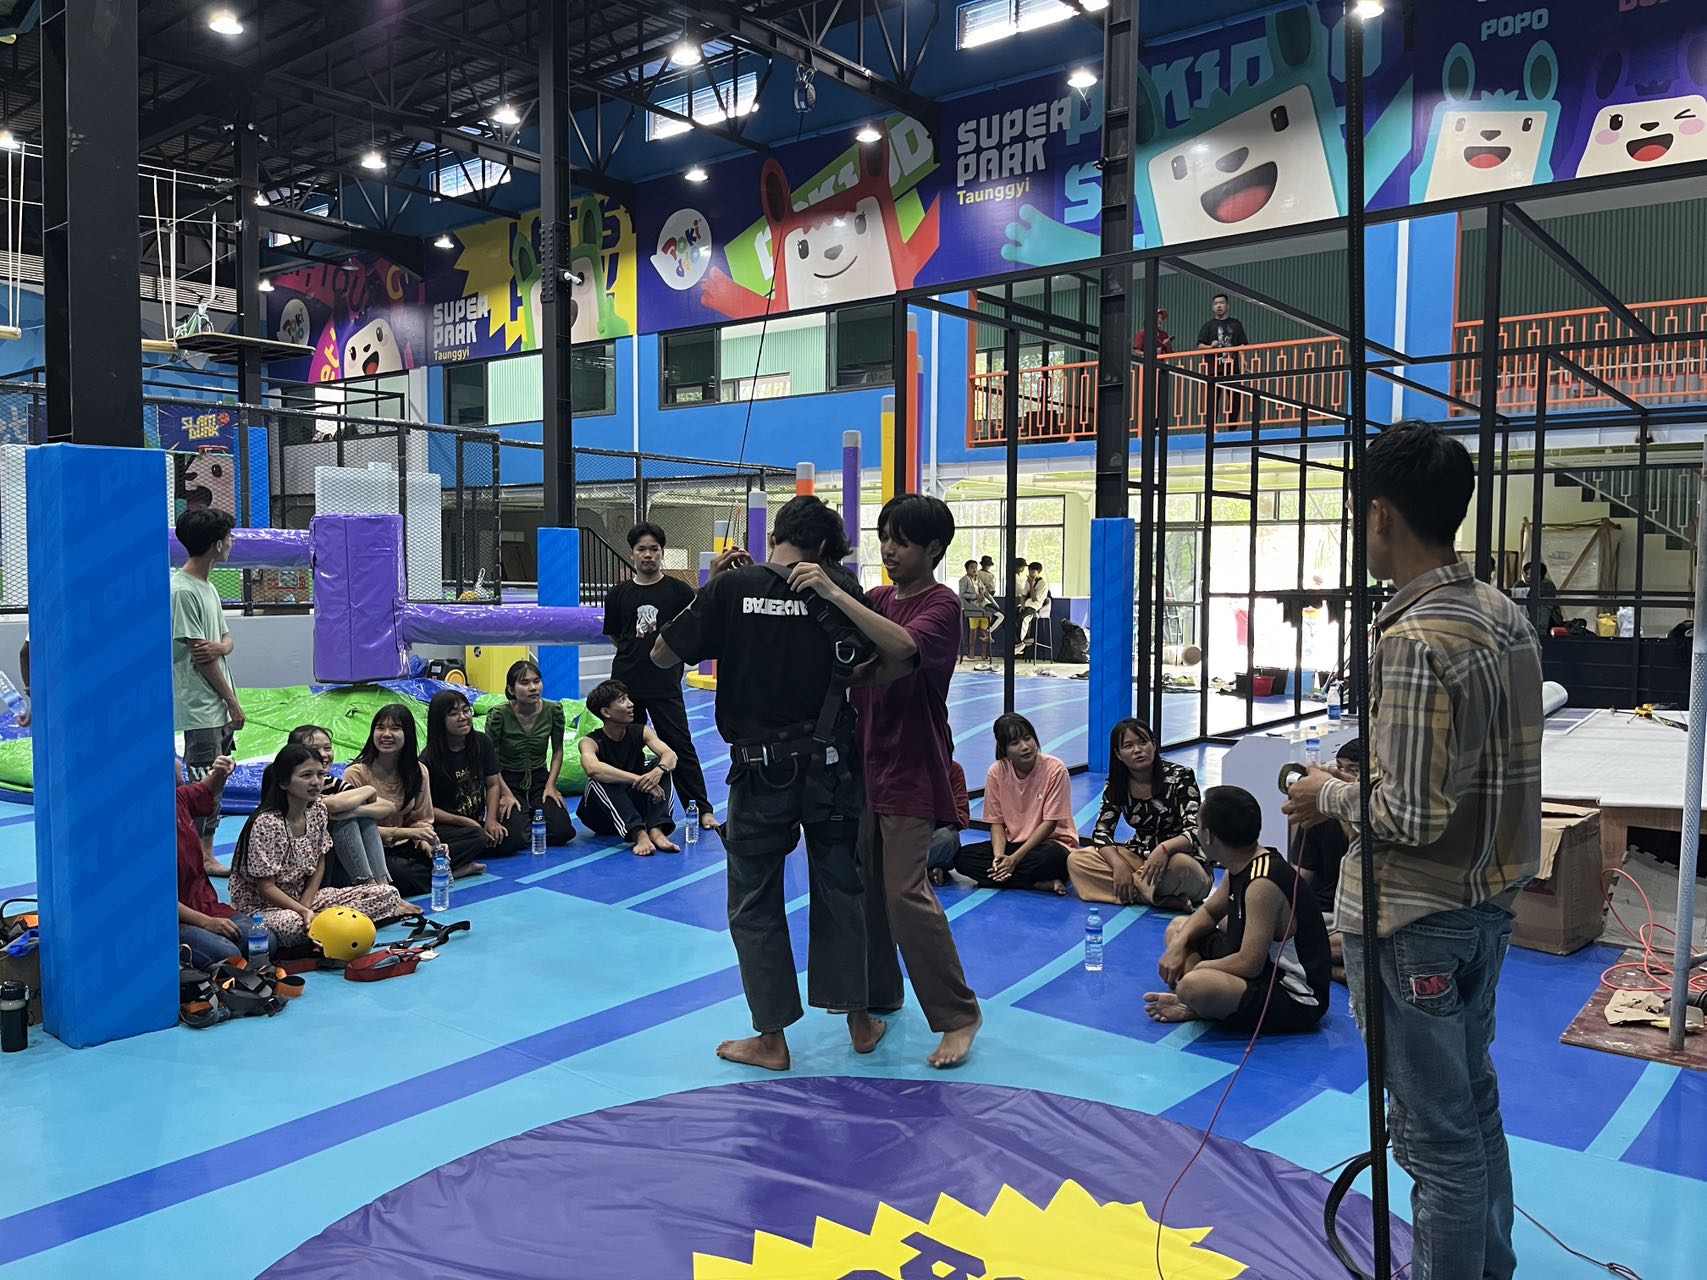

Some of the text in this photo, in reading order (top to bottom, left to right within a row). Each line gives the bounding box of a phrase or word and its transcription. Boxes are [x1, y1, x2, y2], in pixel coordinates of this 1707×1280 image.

[1481, 8, 1549, 42] POPO
[957, 97, 1072, 155] SUPER
[957, 137, 1047, 188] PARK
[957, 177, 1031, 206] Taunggyi
[433, 295, 490, 326] SUPER
[433, 320, 478, 348] PARK
[434, 346, 470, 361] Taunggyi
[181, 413, 217, 431] SLAM
